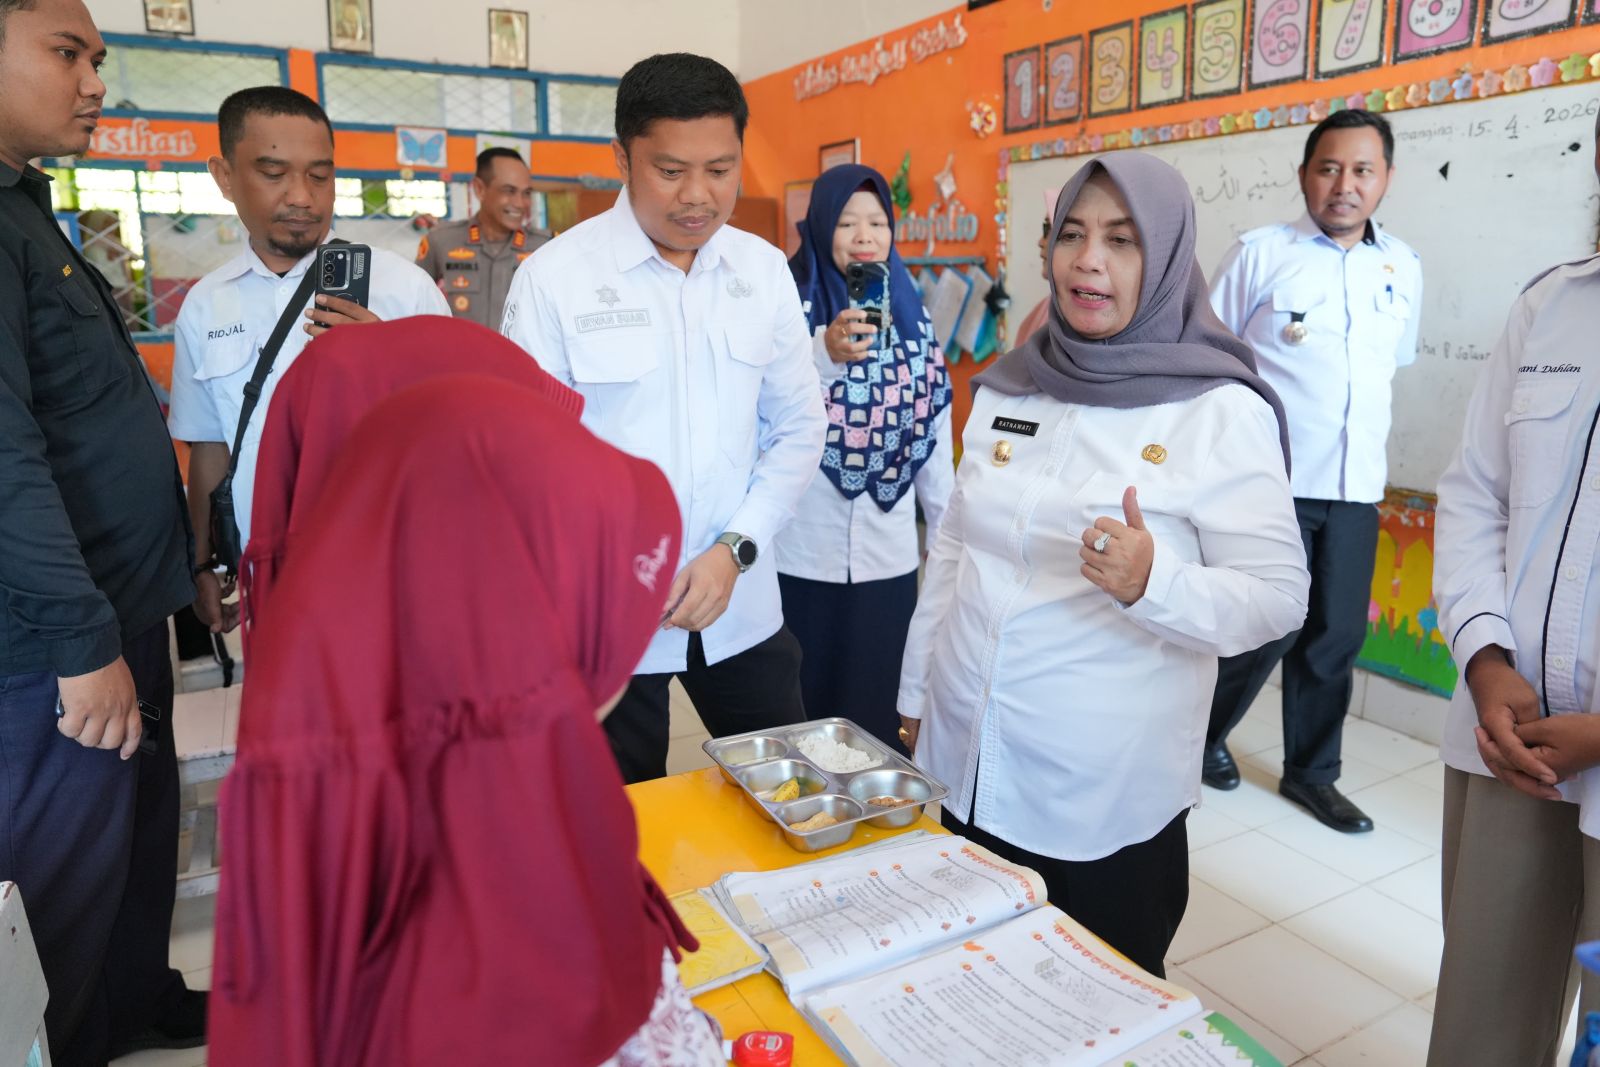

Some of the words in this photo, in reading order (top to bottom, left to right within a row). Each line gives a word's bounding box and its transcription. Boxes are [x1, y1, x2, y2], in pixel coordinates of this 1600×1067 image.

[1015, 59, 1033, 119] 1
[1051, 53, 1077, 109] 2
[1097, 36, 1125, 104] 3
[1146, 27, 1179, 89] 4
[1198, 10, 1236, 82] 5
[1258, 0, 1300, 66] 6
[1543, 98, 1598, 123] 2026
[207, 323, 246, 341] RIDJAL
[1541, 363, 1581, 374] Dahlan
[997, 419, 1033, 432] RATNAWATI
